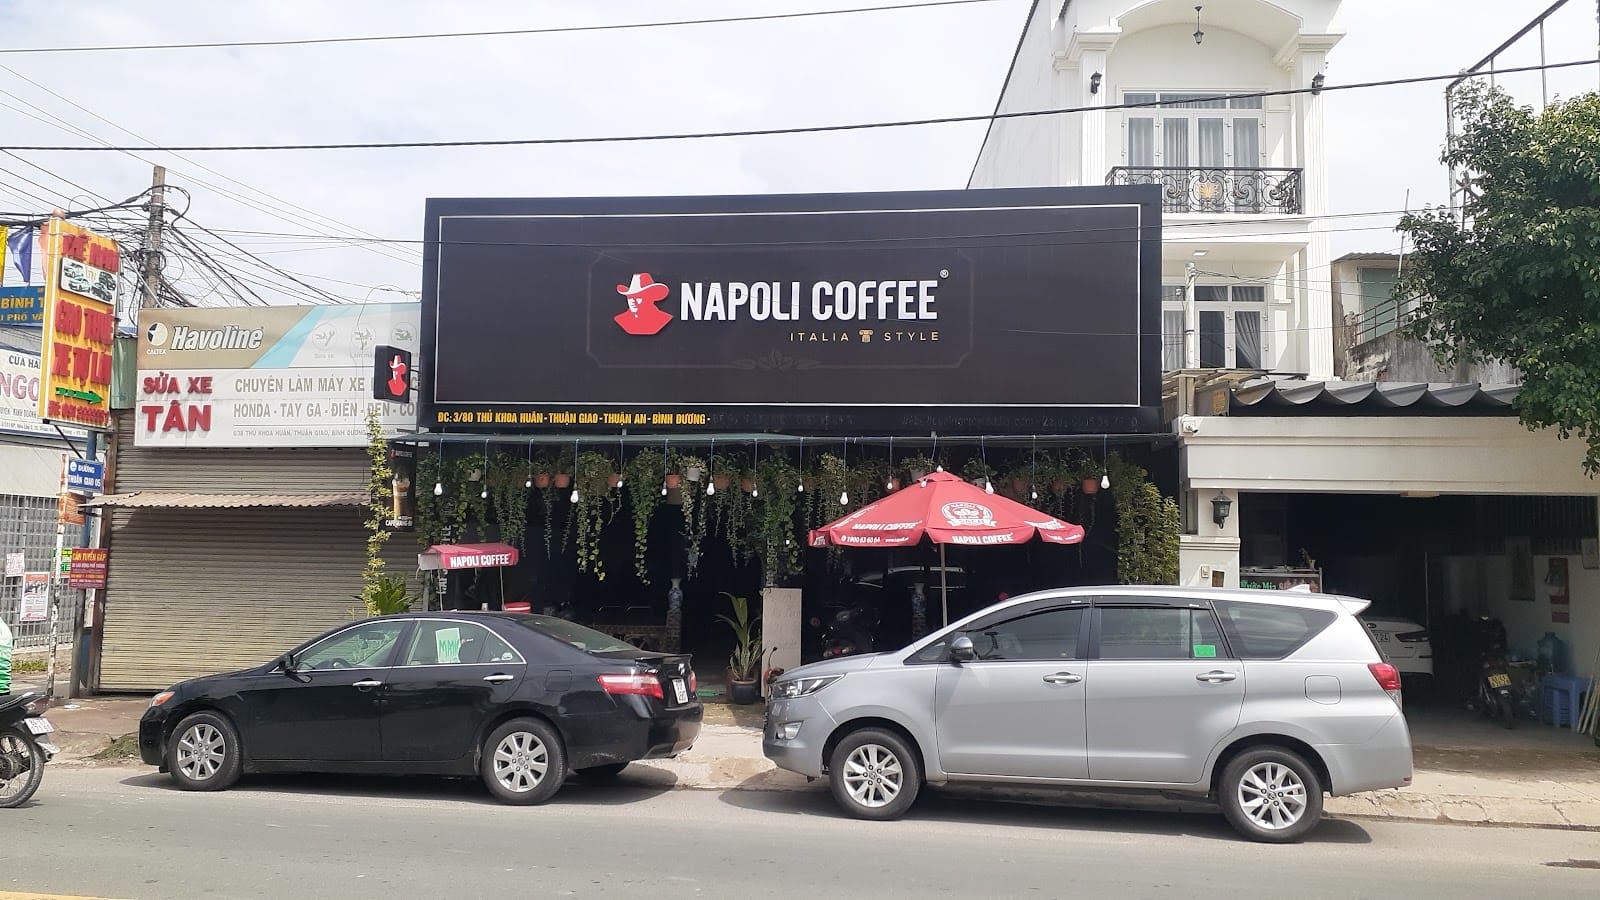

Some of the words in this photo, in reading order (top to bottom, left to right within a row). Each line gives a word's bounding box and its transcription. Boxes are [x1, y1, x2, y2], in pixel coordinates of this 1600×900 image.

[1, 294, 34, 309] BÌNH
[680, 282, 800, 321] NAPOLI
[811, 280, 938, 320] COFFEE
[171, 325, 263, 351] Havoline
[789, 332, 849, 343] ITALIA
[884, 331, 939, 342] STYLE
[143, 371, 180, 394] SỬA
[188, 376, 213, 394] XE
[235, 374, 283, 393] CHUYÊN
[288, 373, 313, 393] LÀM
[318, 372, 344, 392] MÁY
[349, 377, 365, 392] XE
[142, 400, 212, 432] TÂN
[233, 402, 271, 418] HONDA
[280, 402, 303, 418] TAY
[306, 402, 322, 418] GA
[453, 412, 474, 423] 3/80
[477, 409, 493, 423] THỦ
[495, 412, 518, 424] KHOA
[520, 411, 543, 424] HUÂN
[549, 411, 576, 425] THUẬN
[578, 413, 599, 424] GIAO
[604, 412, 632, 426] THUẬN
[634, 414, 647, 425] AN
[652, 412, 673, 425] BÌNH
[84, 477, 95, 486] GIAO
[95, 478, 101, 488] 05
[951, 535, 982, 545] NAPOLI
[982, 534, 1013, 544] COFFEE
[450, 555, 480, 568] NAPOLI
[480, 554, 509, 566] COFFEE
